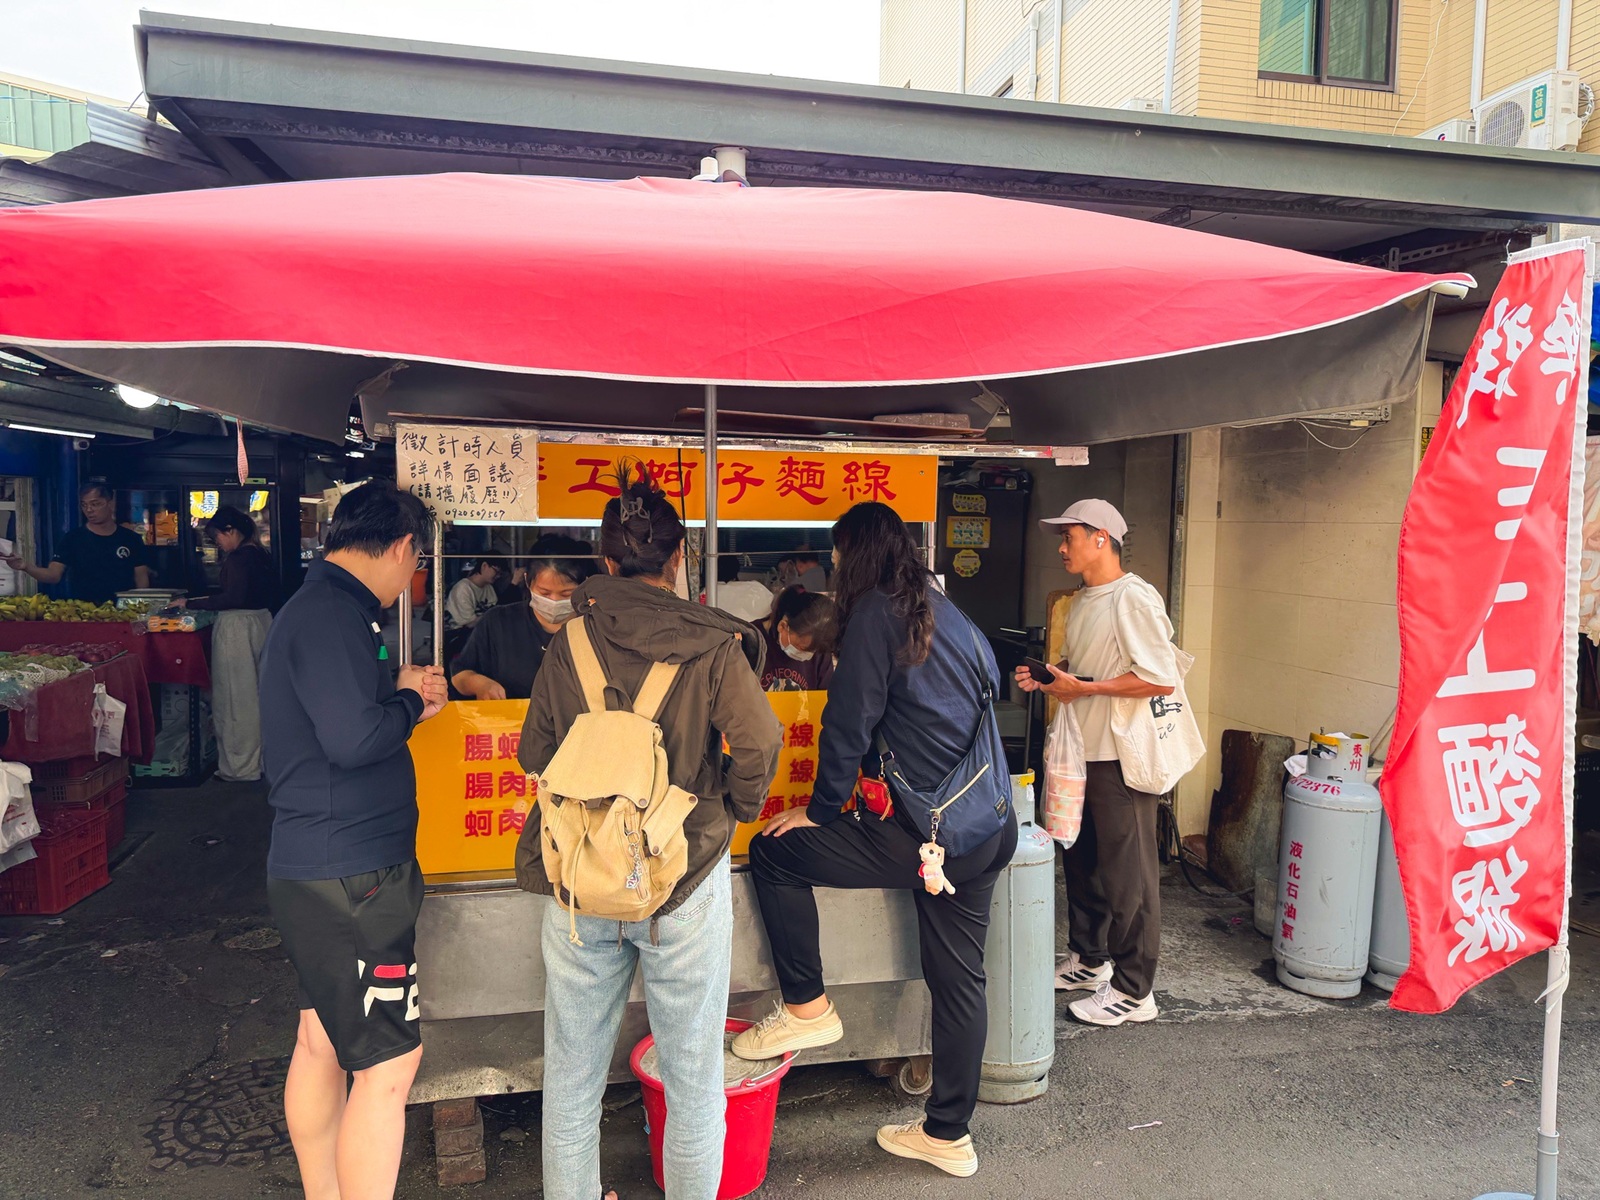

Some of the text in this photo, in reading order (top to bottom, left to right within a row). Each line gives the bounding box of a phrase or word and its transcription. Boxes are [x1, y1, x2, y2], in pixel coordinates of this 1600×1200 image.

[401, 432, 525, 461] 徵計時人員
[410, 459, 514, 484] 詳情面議
[464, 758, 815, 799] 腸肉 線
[1282, 840, 1303, 941] 液化石油氣
